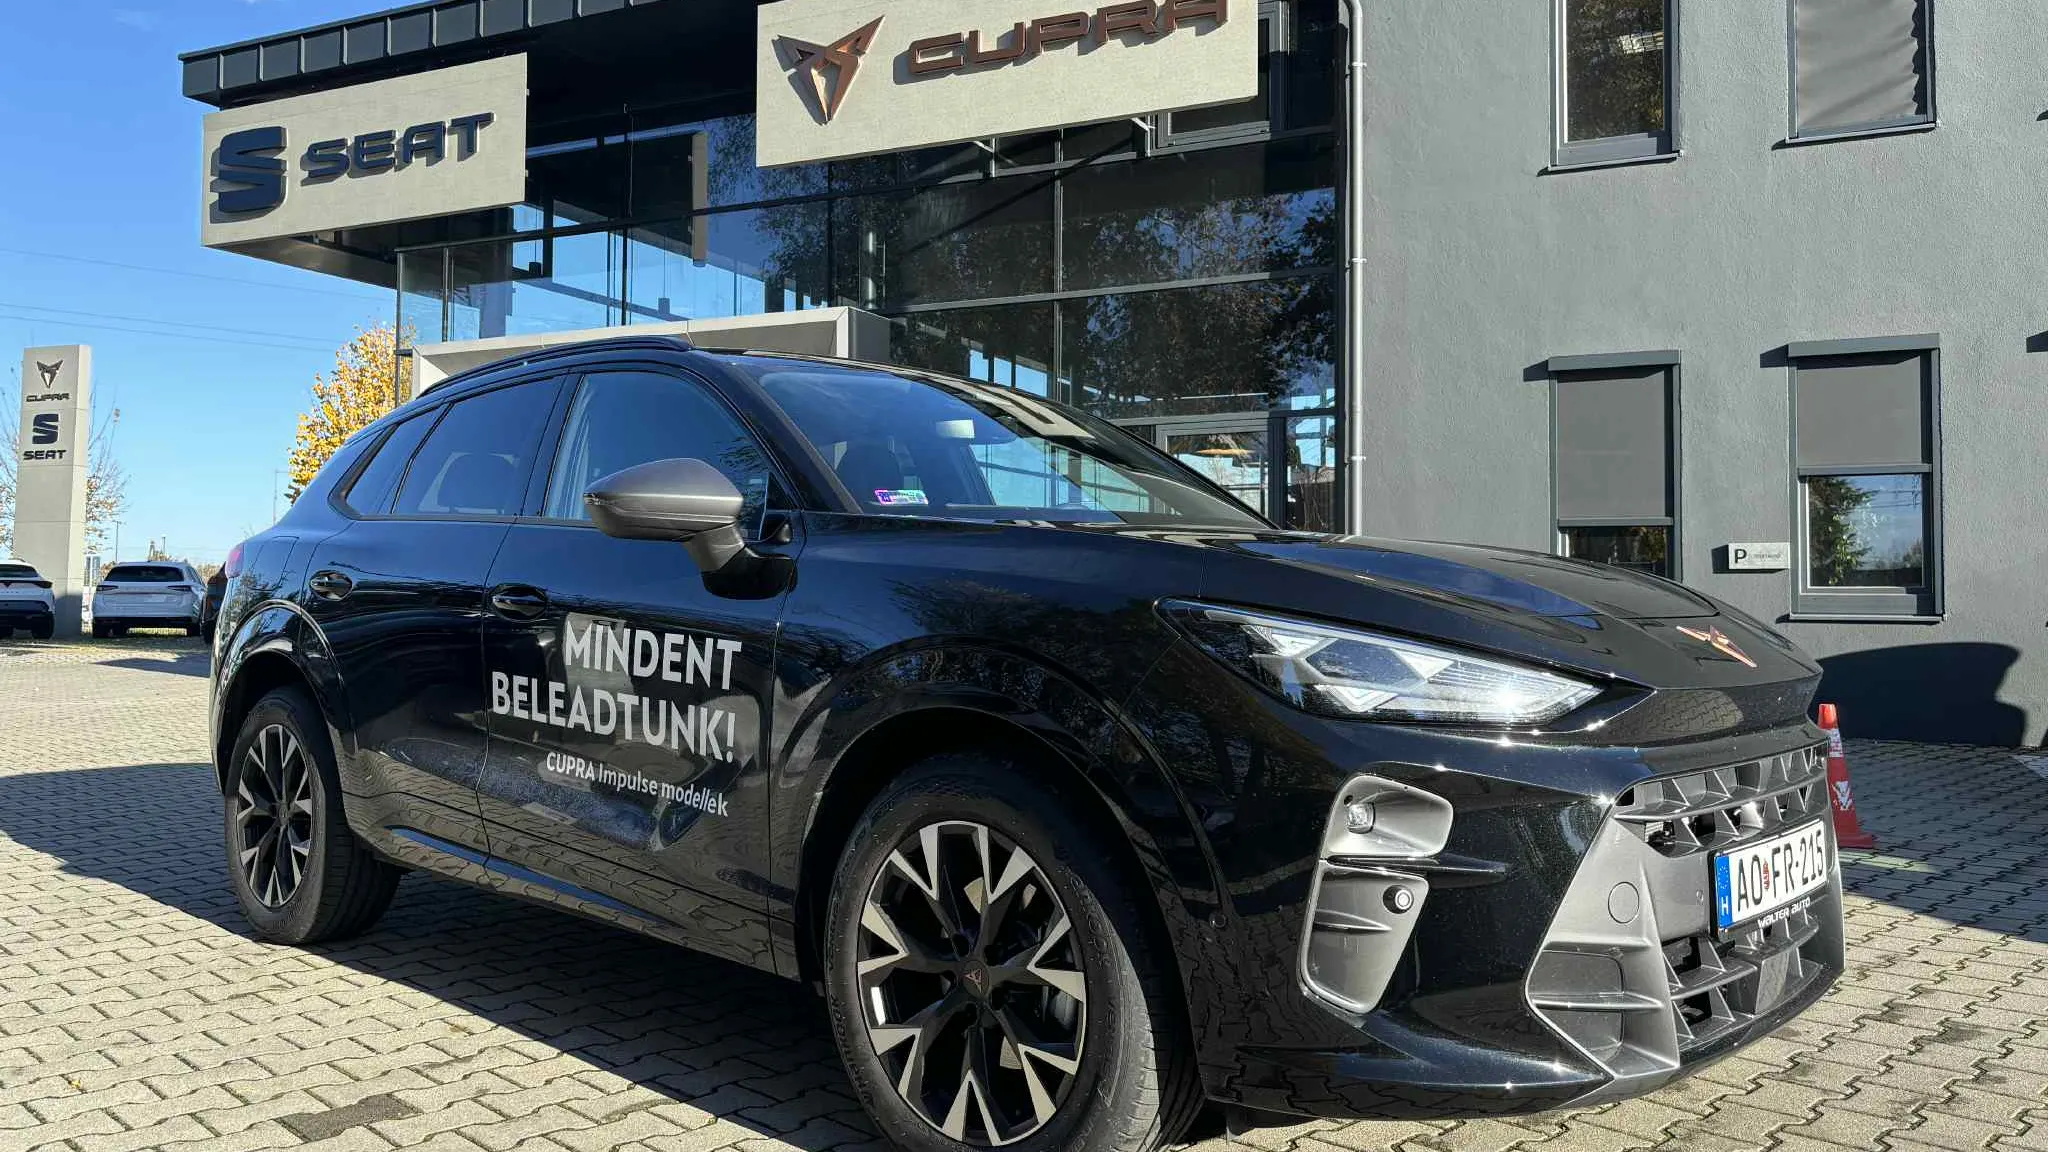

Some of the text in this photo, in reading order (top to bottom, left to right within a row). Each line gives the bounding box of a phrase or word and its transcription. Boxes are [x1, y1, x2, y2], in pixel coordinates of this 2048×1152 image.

[909, 0, 1229, 73] CUPRA
[306, 112, 496, 178] SEAT
[26, 393, 70, 402] CUPRA
[23, 450, 67, 460] SEAT
[1734, 548, 1747, 564] P
[565, 620, 742, 690] MINDENT
[492, 671, 736, 763] BELEADTUNK!
[546, 752, 728, 817] CUPRA Impulse modellek
[1721, 895, 1729, 916] H
